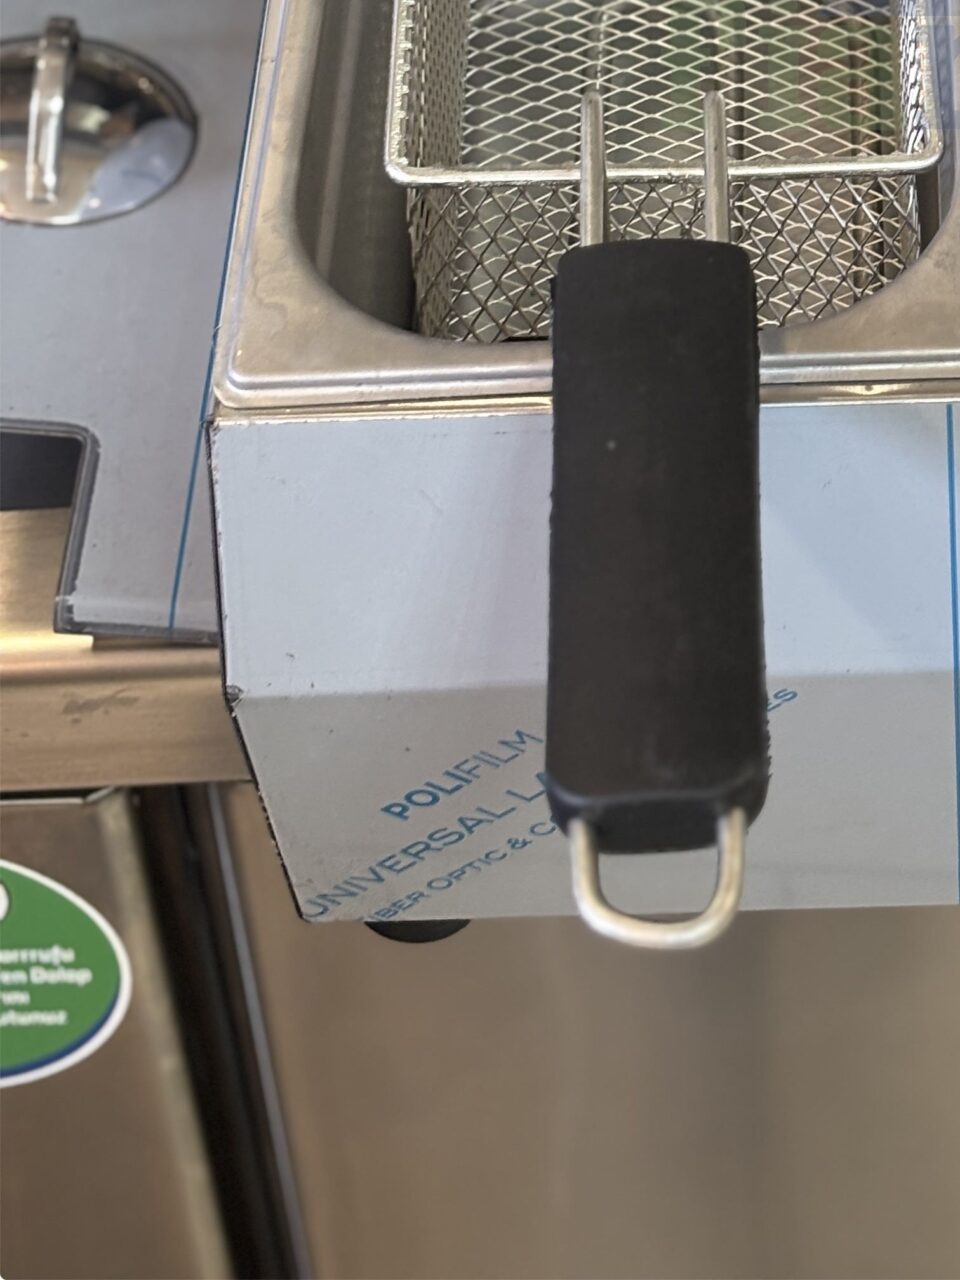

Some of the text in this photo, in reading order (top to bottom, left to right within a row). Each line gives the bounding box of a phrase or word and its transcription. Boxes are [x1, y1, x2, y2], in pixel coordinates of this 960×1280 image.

[381, 729, 544, 820] POLIFILM
[303, 805, 517, 919] UNIVERSAL
[426, 849, 508, 890] OPTIC
[506, 837, 533, 850] &
